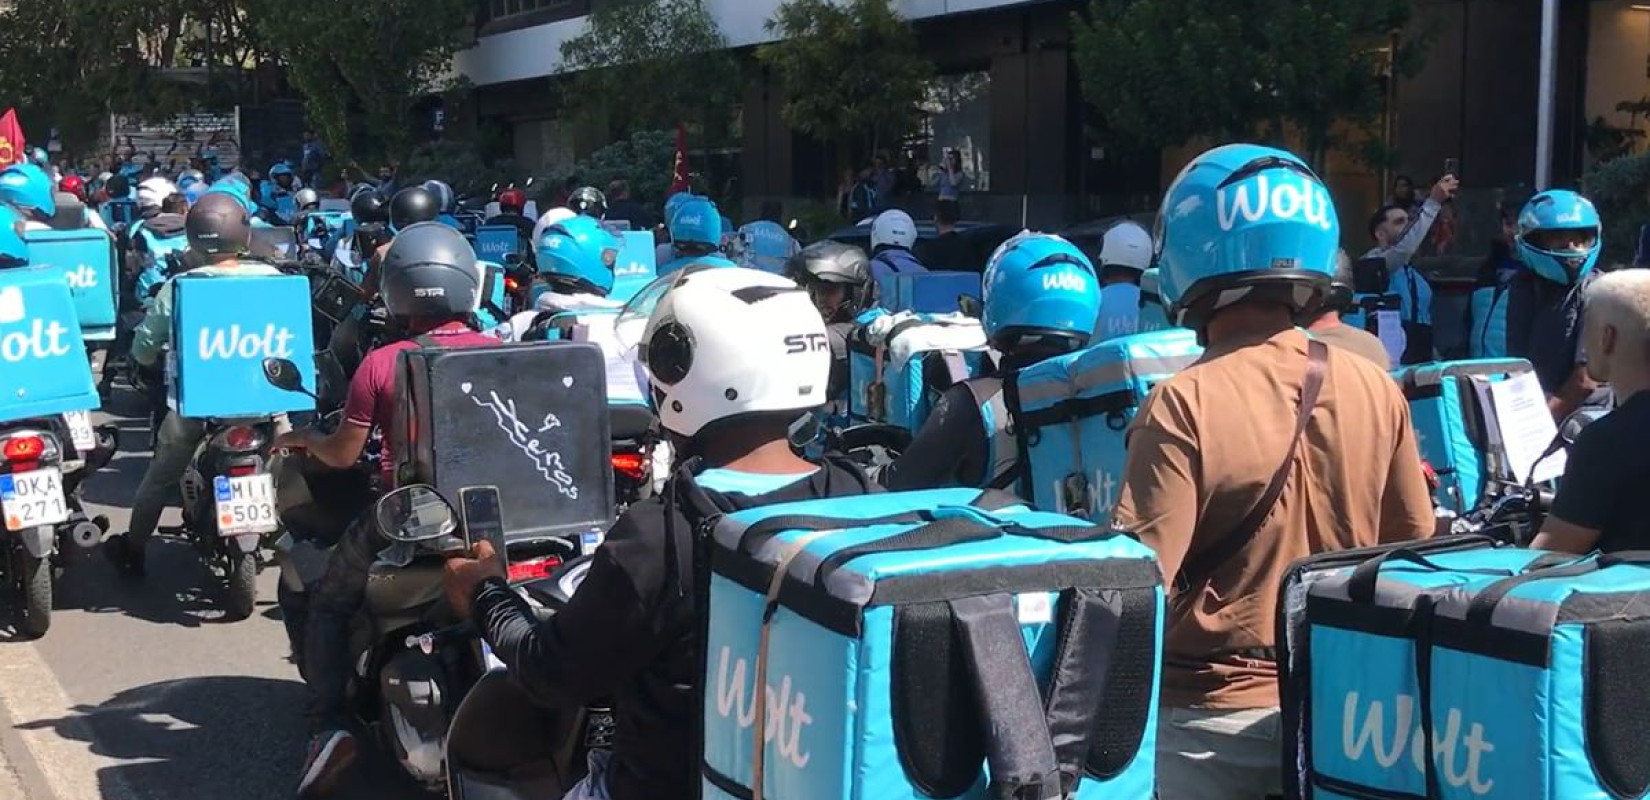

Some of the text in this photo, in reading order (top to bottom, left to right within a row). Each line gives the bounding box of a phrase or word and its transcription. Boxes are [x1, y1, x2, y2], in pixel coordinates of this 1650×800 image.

[1217, 173, 1332, 231] Wolt
[414, 287, 445, 298] STR
[2, 317, 71, 363] olt
[199, 322, 295, 361] Wolt
[783, 333, 829, 354] STR
[233, 502, 272, 522] 503
